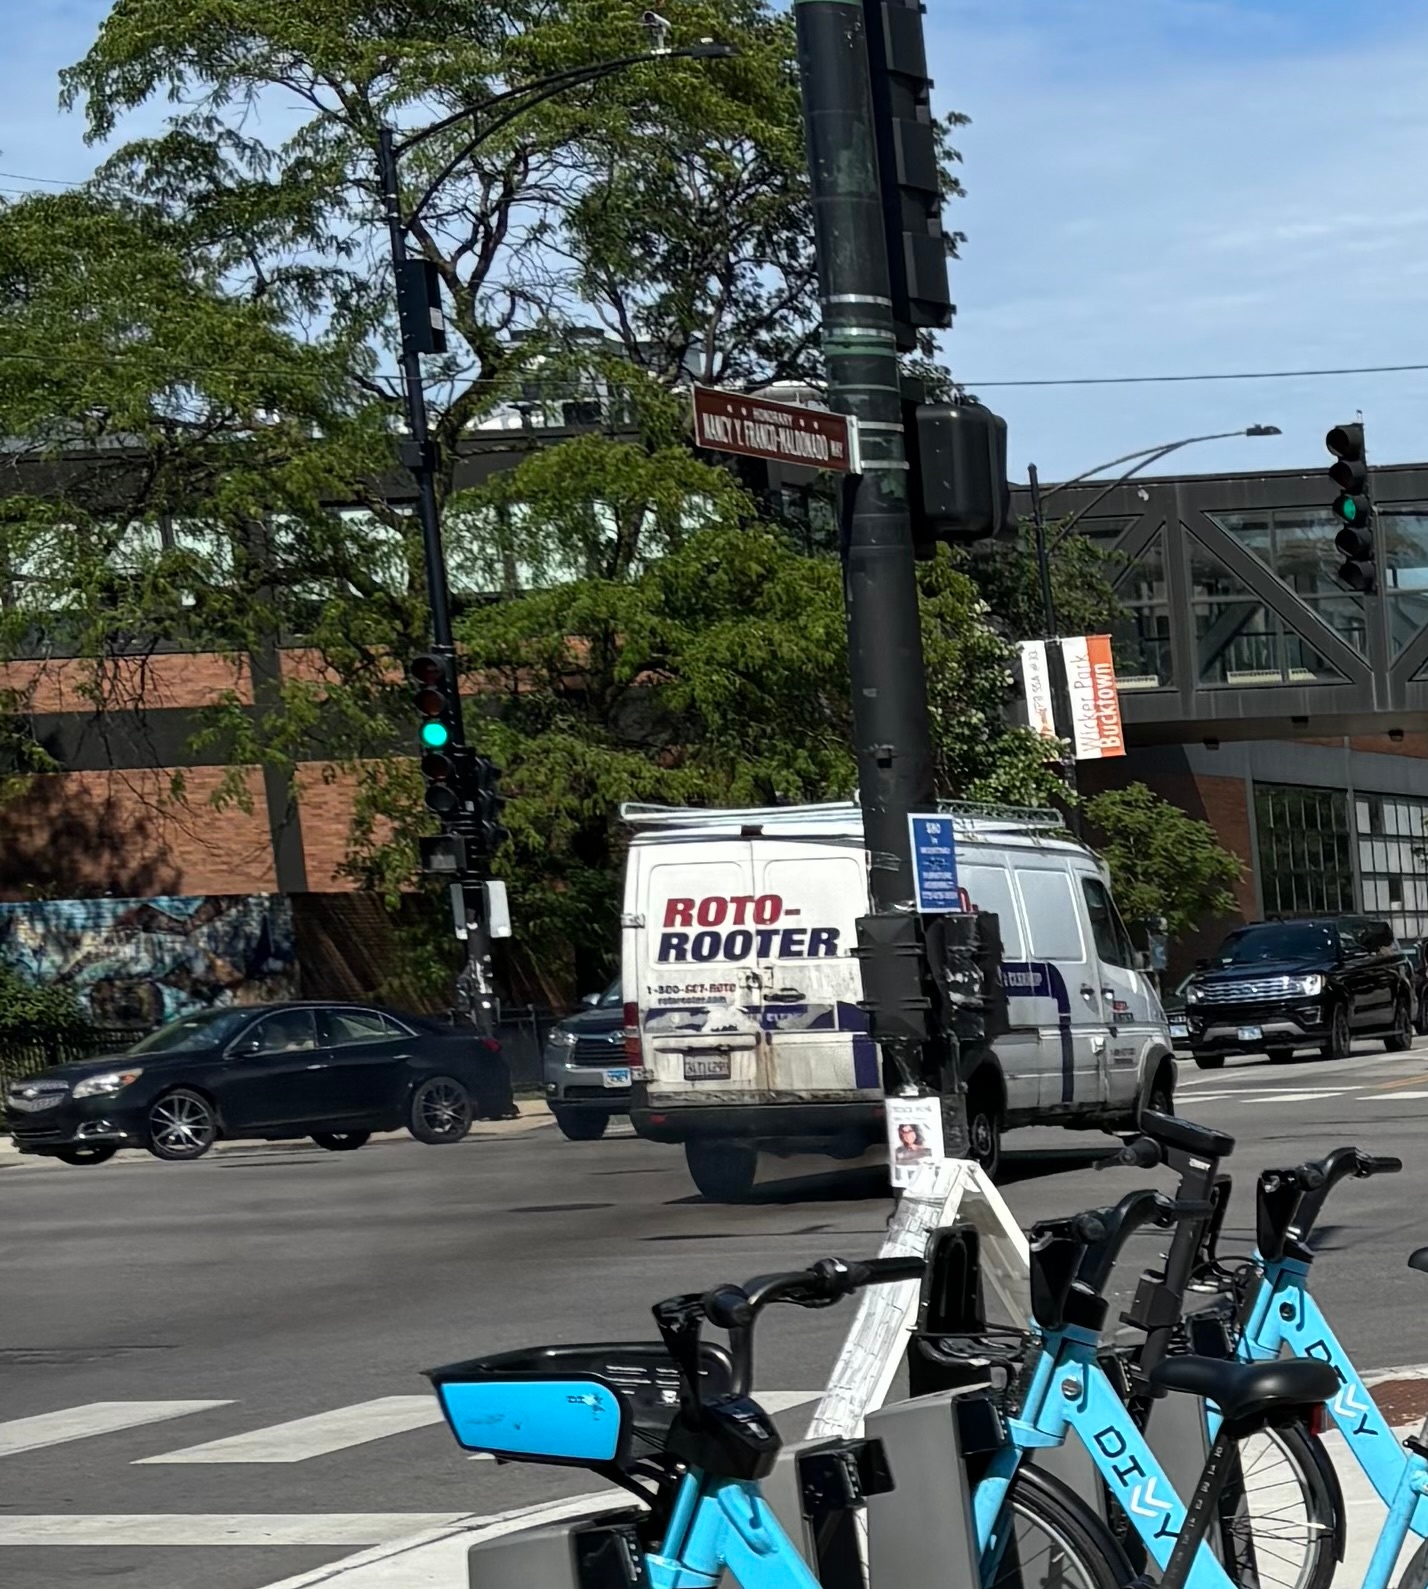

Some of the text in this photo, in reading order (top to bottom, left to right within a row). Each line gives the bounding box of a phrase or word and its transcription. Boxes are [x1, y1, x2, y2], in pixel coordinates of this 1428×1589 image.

[1070, 655, 1101, 752] Wicker Park
[1094, 663, 1121, 748] Bucktown
[663, 894, 801, 928] ROTO-
[657, 927, 841, 963] ROOTER
